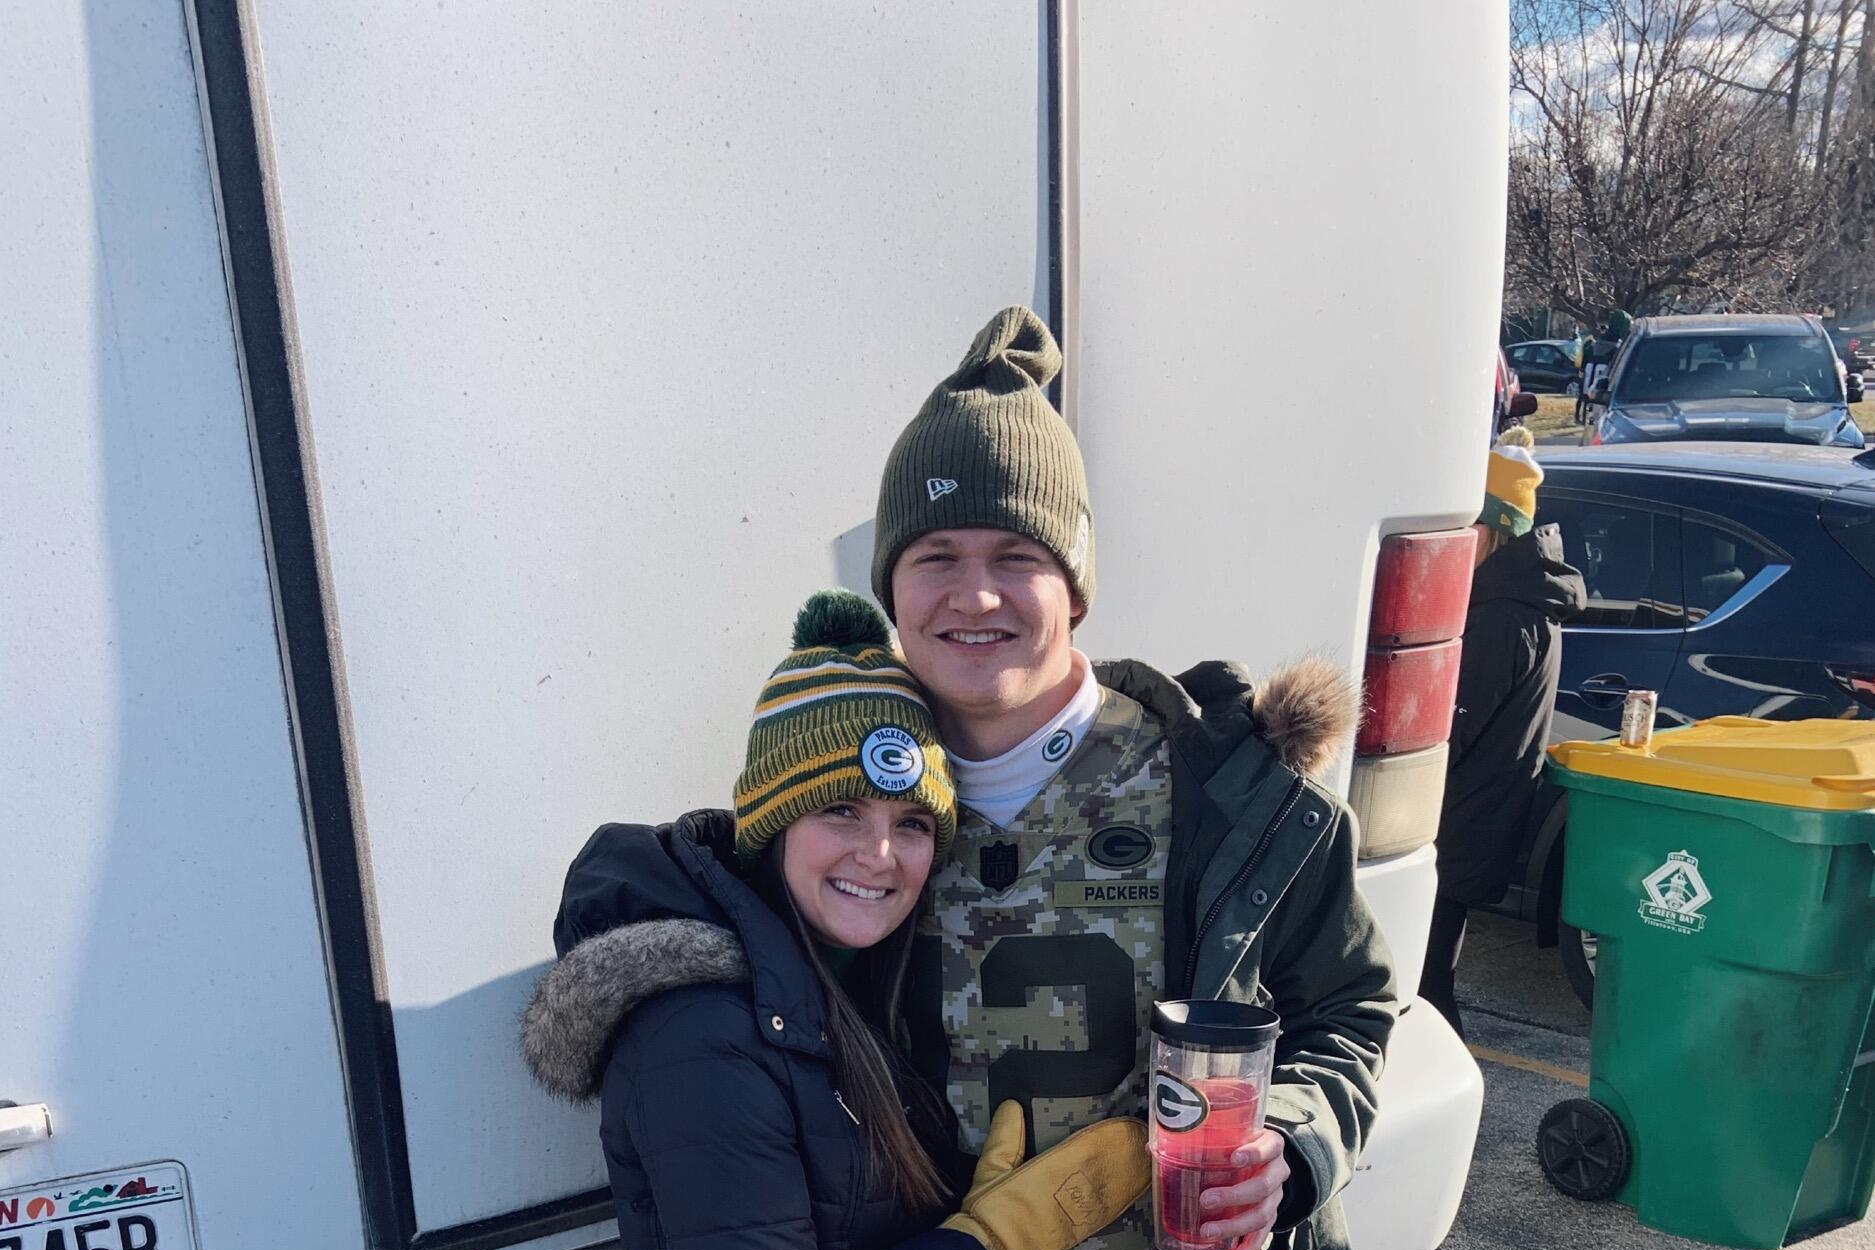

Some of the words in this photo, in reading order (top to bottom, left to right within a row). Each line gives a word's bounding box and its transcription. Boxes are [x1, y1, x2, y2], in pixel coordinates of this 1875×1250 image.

[875, 729, 911, 745] PACKERS
[1084, 886, 1159, 901] PACKERS
[1649, 907, 1676, 919] GREEN
[1679, 914, 1695, 925] BAY
